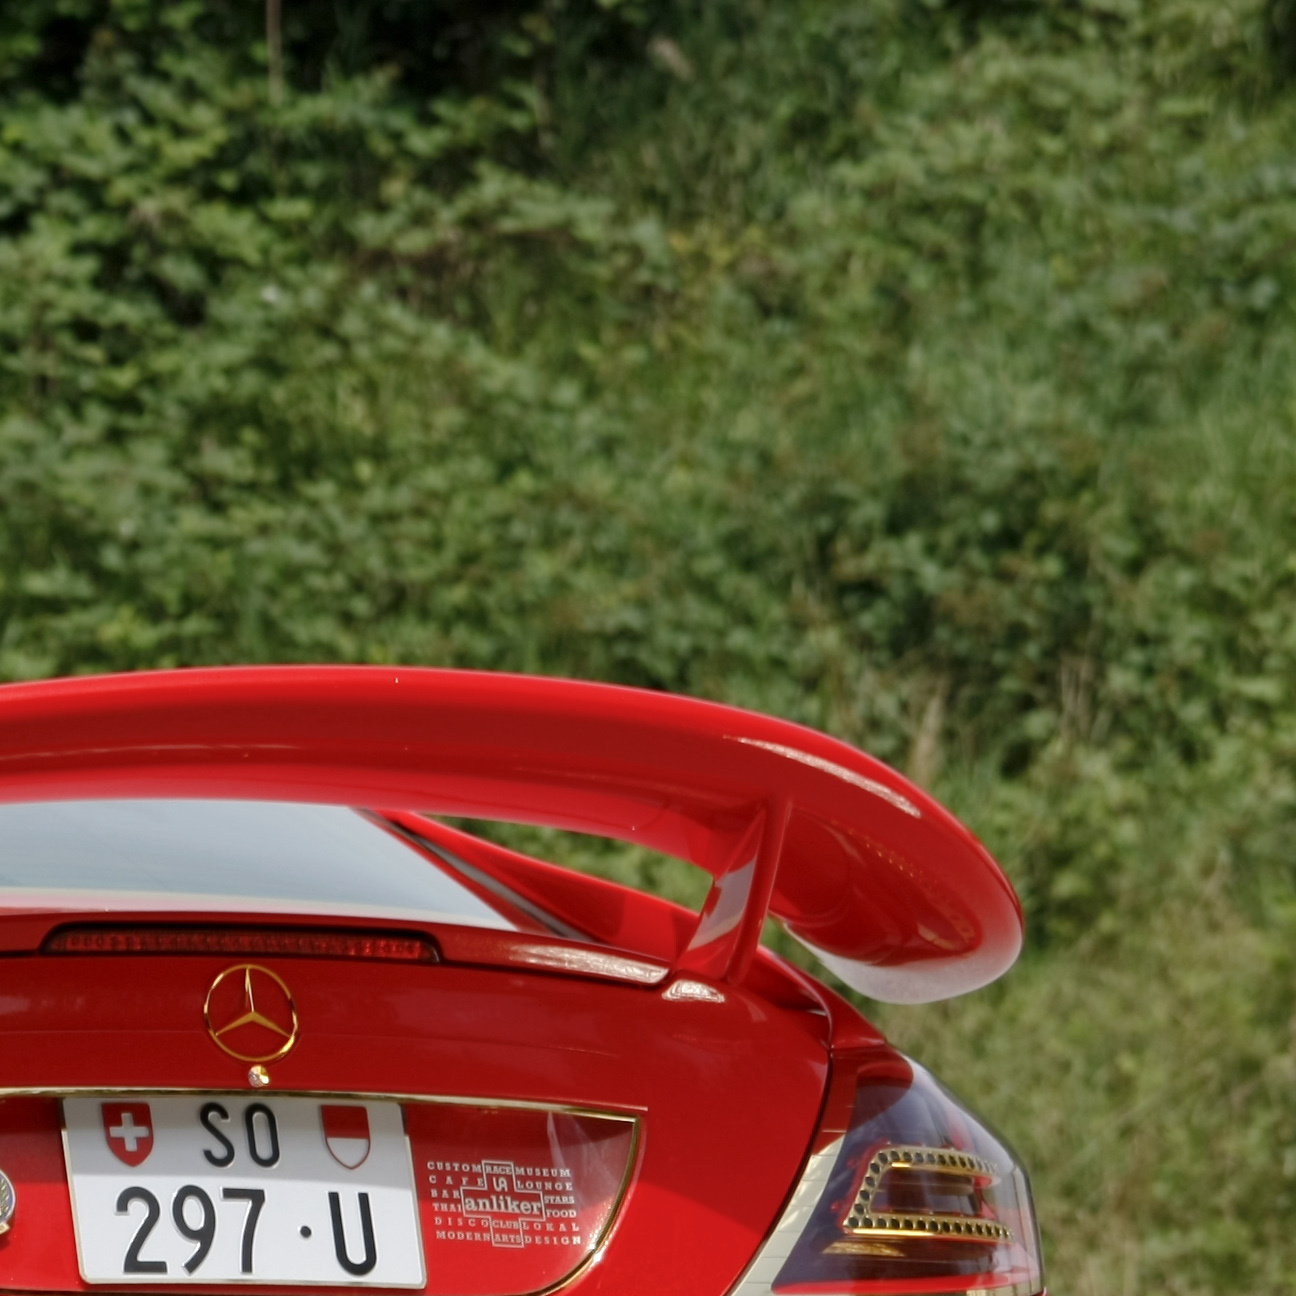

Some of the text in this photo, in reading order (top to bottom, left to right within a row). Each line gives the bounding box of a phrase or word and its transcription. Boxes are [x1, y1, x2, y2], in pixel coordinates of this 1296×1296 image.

[200, 1102, 280, 1168] SO
[427, 1161, 572, 1178] CUSTOM RACE MUSEUM
[428, 1175, 484, 1187] CAFE
[516, 1180, 573, 1192] LOUNGE
[430, 1188, 461, 1199] BAR
[464, 1195, 542, 1216] anliker
[544, 1195, 575, 1206] STARS
[432, 1202, 462, 1213] THAI
[546, 1209, 577, 1219] FOOD
[434, 1217, 580, 1233] DISCO CLUB LOKAL
[436, 1230, 582, 1246] MODERN ARTS DESIGN
